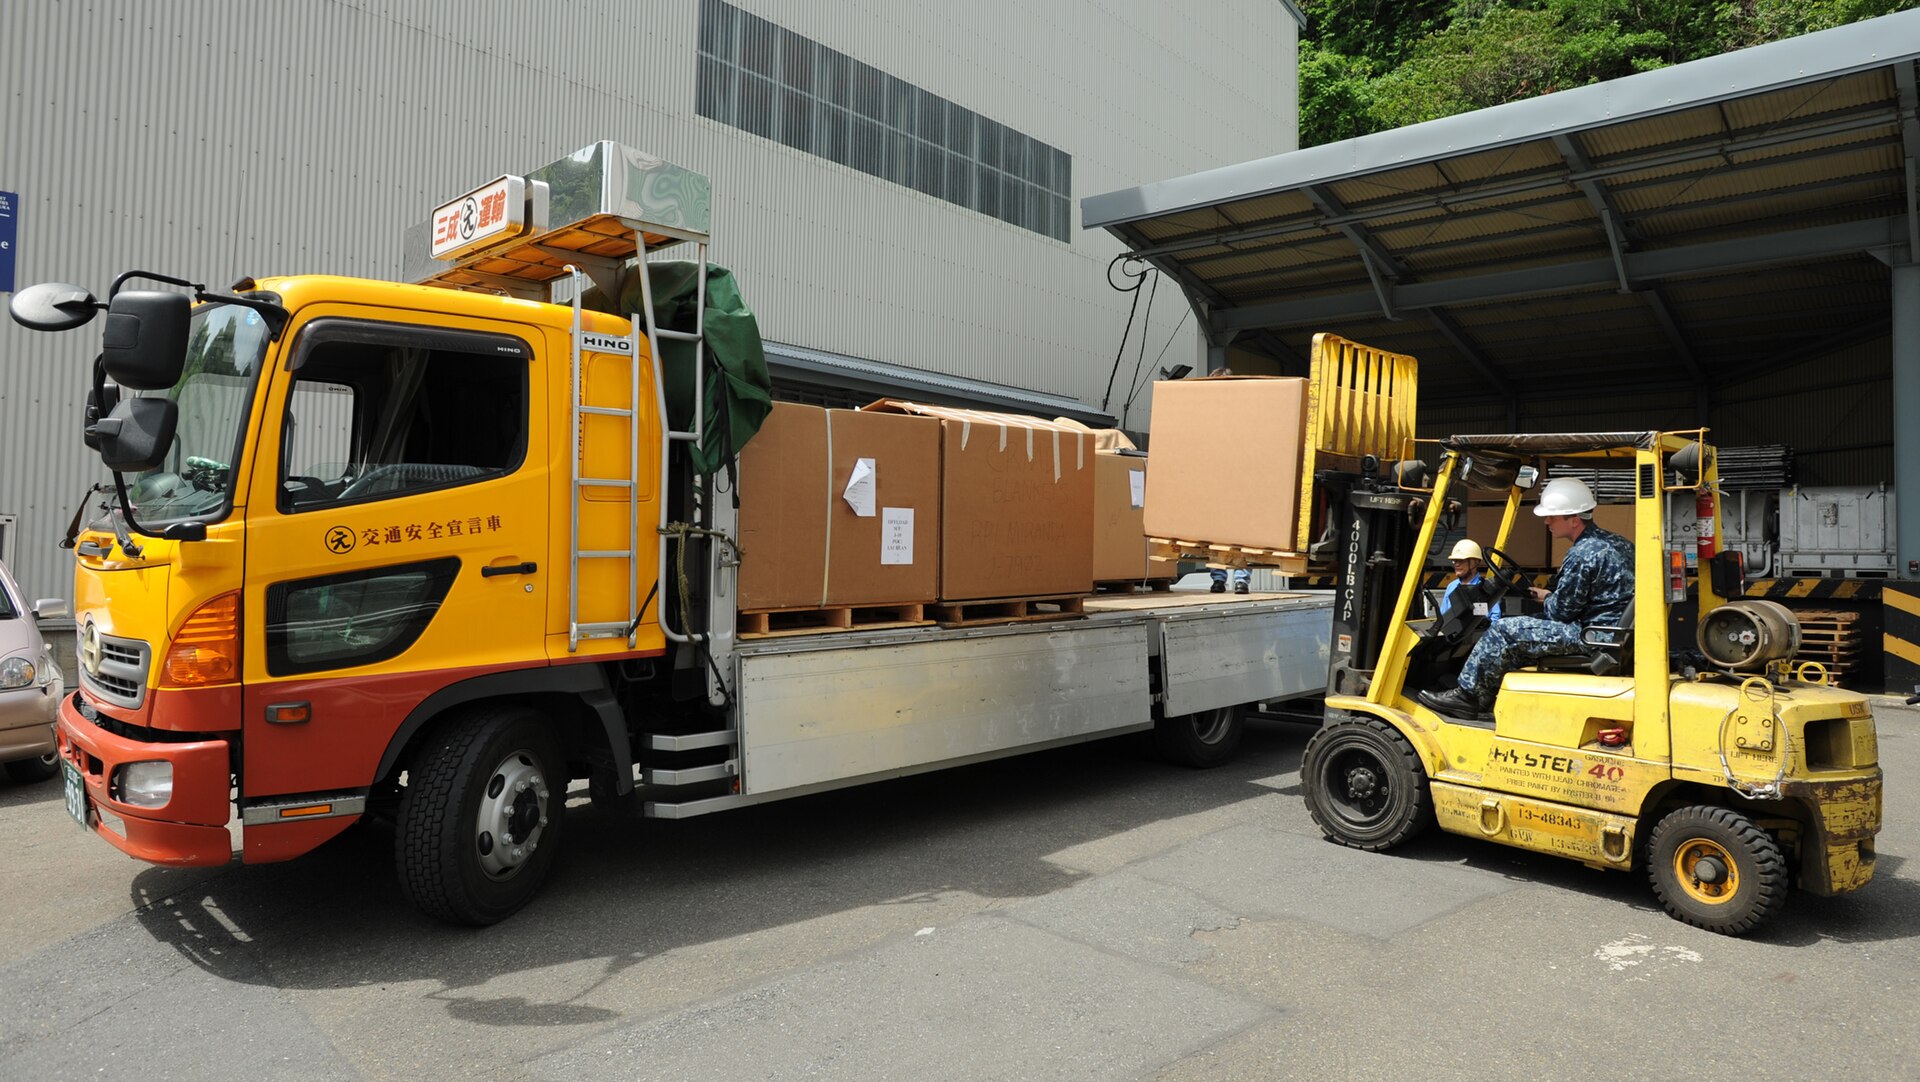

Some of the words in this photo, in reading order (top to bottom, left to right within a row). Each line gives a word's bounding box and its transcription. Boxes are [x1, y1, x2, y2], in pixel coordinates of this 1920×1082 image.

[435, 210, 460, 246] 三成
[477, 189, 506, 229] 運輸
[497, 346, 521, 354] HINO
[584, 336, 630, 351] HINO
[361, 515, 502, 547] 交通安全宣言車
[1500, 765, 1531, 777] PAINTED
[1553, 775, 1574, 786] LEAD
[1588, 763, 1625, 784] 40
[1506, 778, 1526, 788] FREE
[1527, 781, 1549, 792] PAINT
[1550, 786, 1560, 794] BY
[1519, 808, 1581, 830] 13-48343
